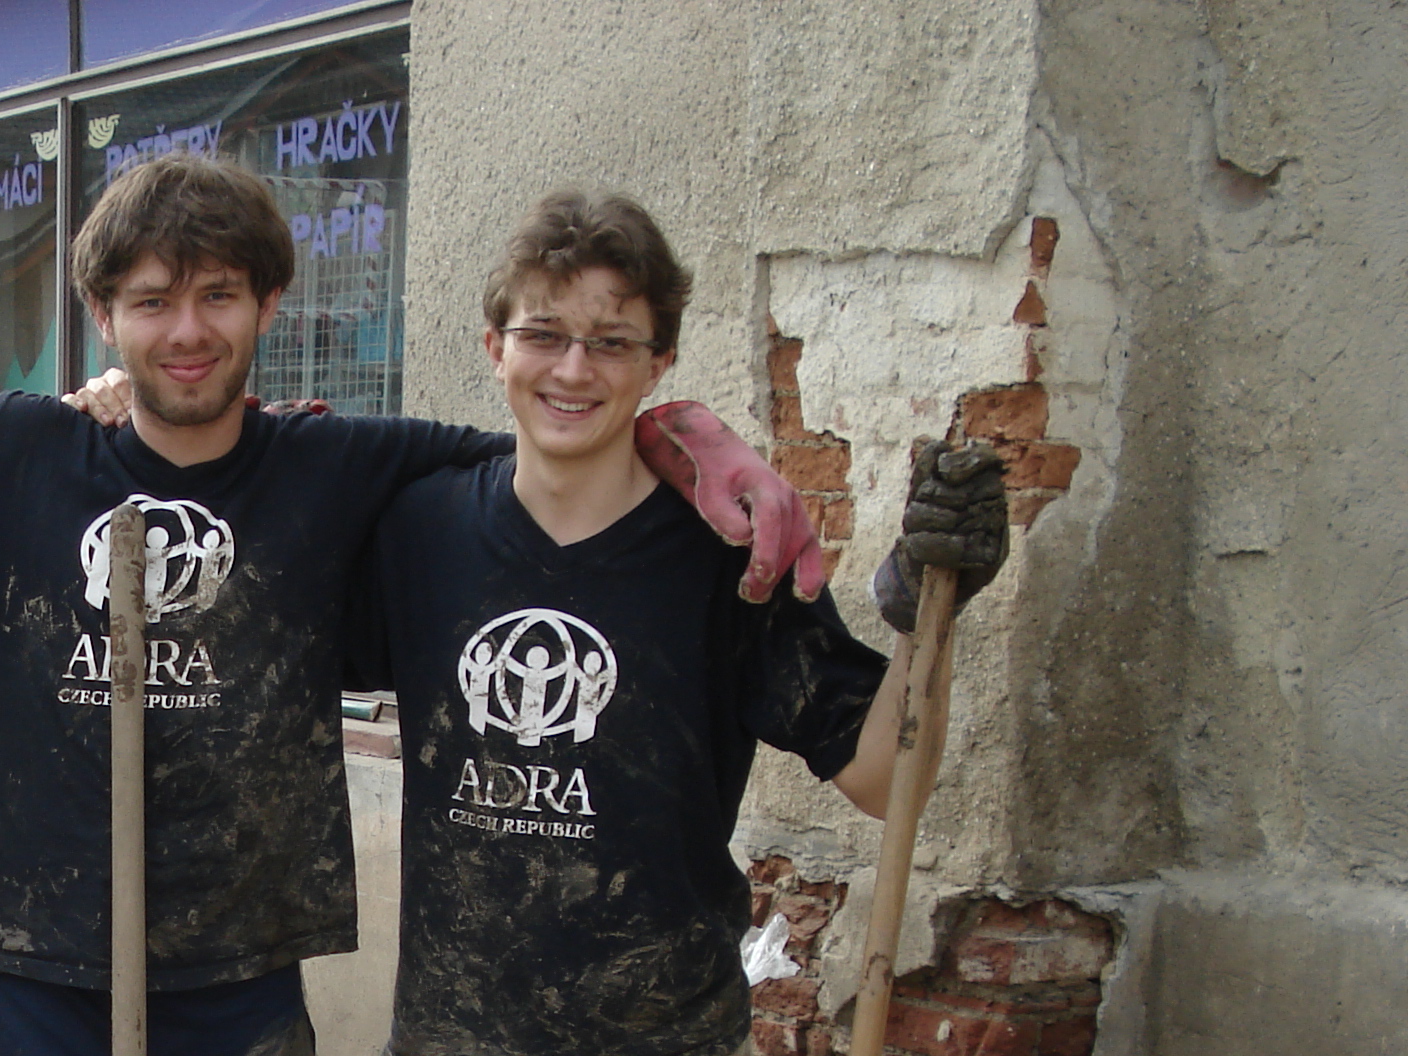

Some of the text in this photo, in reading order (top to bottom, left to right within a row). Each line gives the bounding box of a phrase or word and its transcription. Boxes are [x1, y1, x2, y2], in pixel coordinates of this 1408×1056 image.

[277, 100, 401, 171] HRAČKY
[290, 182, 385, 260] PAPÍR
[143, 692, 221, 709] PUBLIC
[451, 757, 597, 816] ADRA
[448, 808, 595, 840] CZECH REPUBLIC
